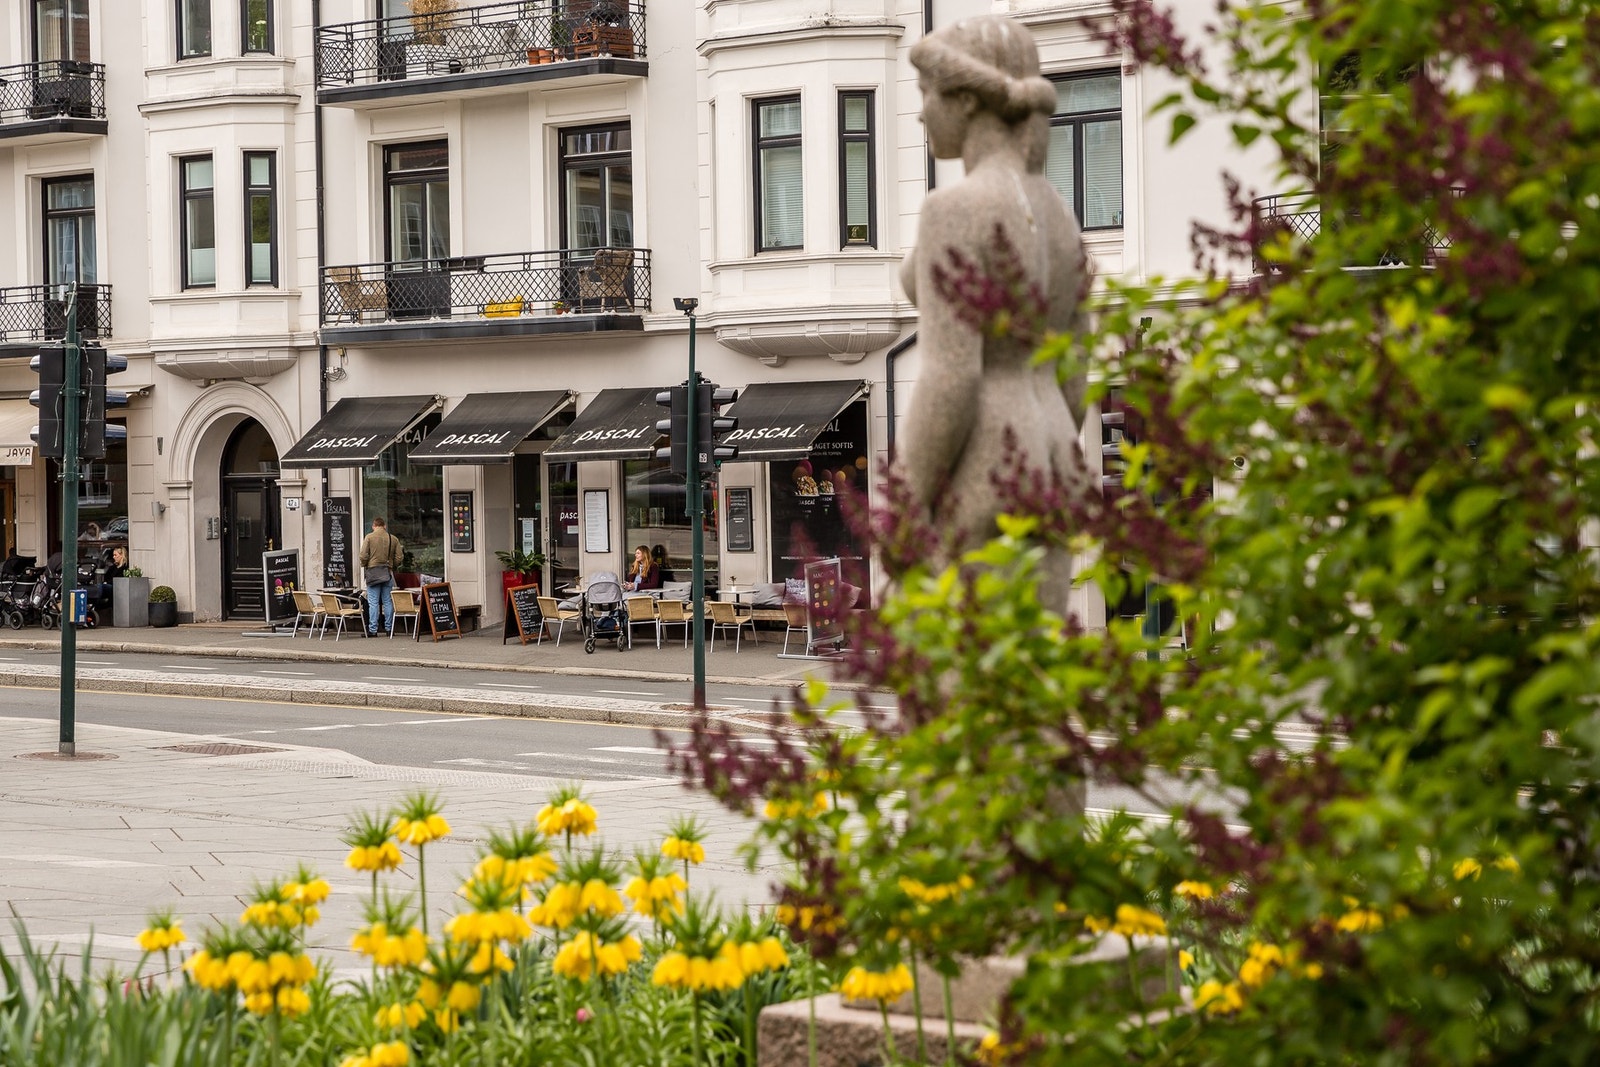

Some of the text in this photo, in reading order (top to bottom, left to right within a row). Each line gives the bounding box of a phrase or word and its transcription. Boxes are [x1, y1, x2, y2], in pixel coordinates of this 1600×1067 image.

[307, 434, 378, 451] PASCAL
[435, 430, 511, 448] PASCAL
[573, 425, 650, 444] PASCAL
[723, 424, 805, 444] PASCAL
[6, 448, 31, 457] JAVA
